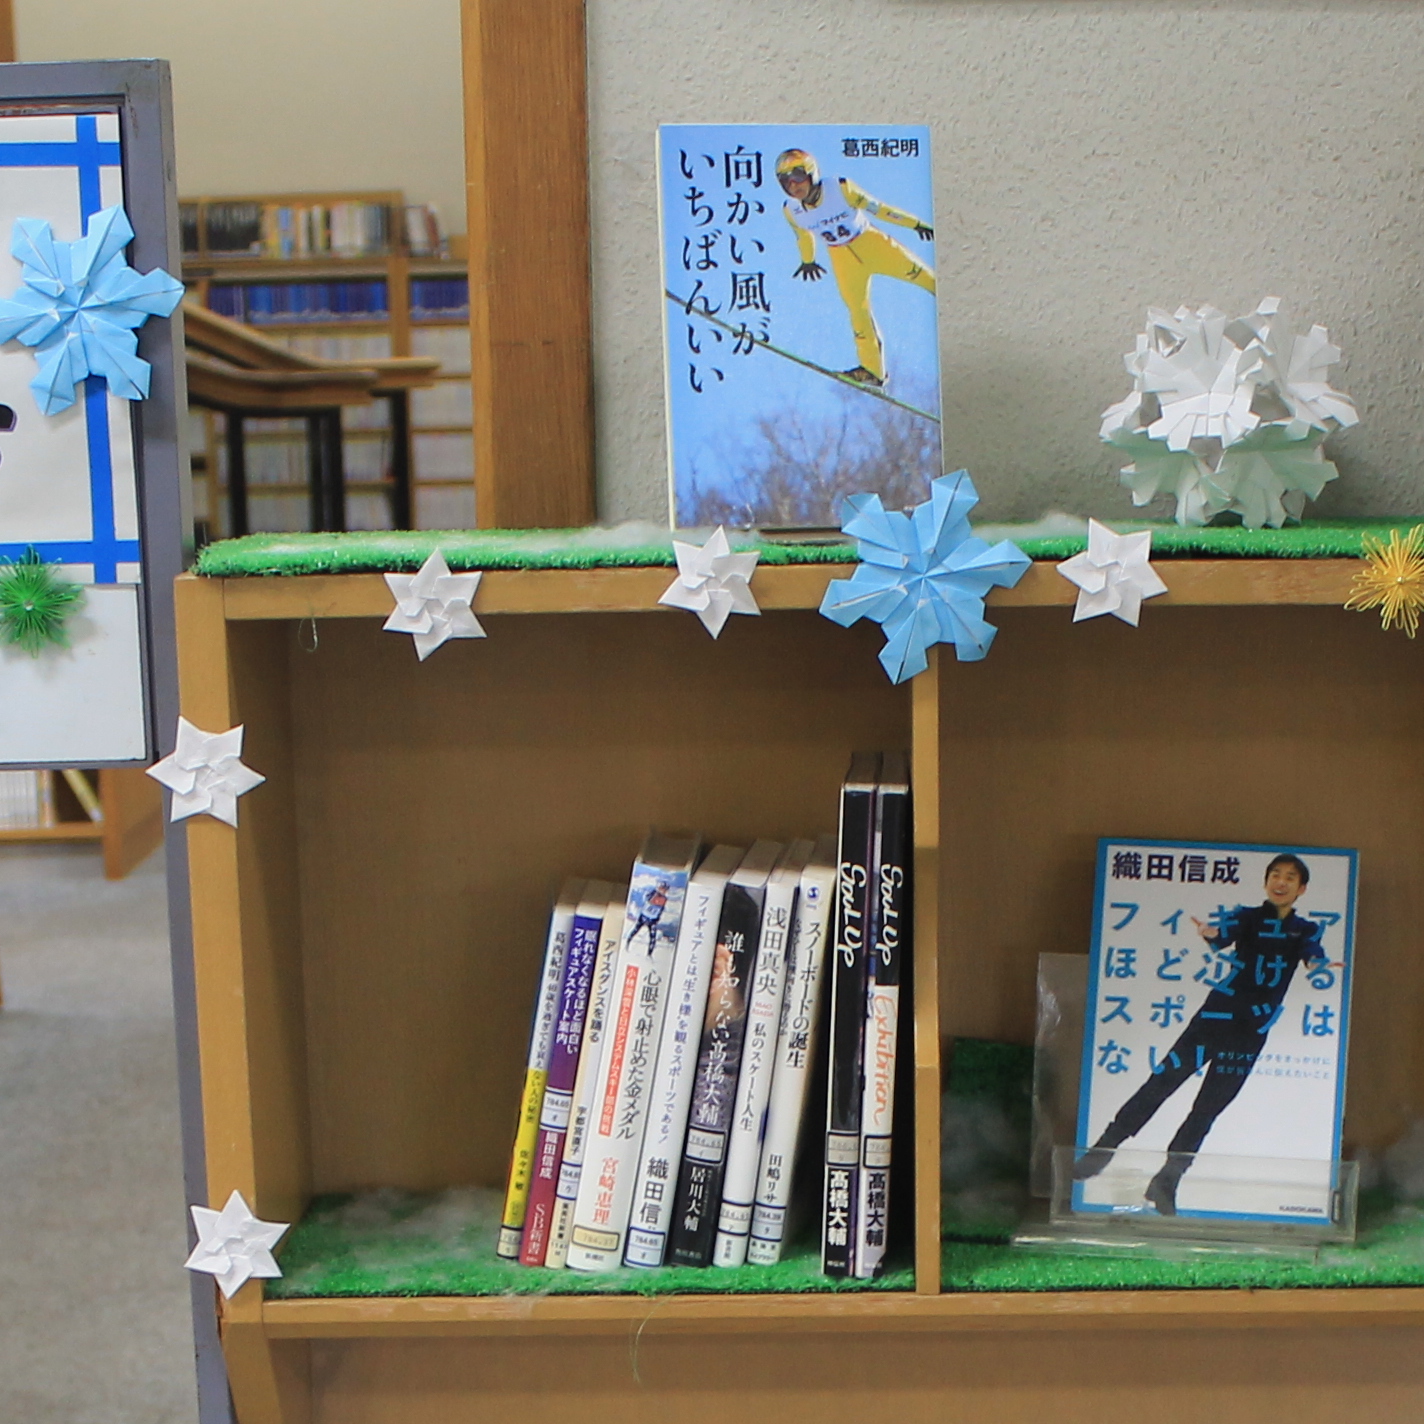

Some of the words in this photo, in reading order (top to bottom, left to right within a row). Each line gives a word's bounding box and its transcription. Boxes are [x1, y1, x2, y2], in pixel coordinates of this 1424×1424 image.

[841, 138, 919, 158] 葛西紀明
[680, 149, 724, 393] いちばんいい
[723, 145, 771, 355] 向かい風が
[1111, 850, 1241, 885] 織田信成
[756, 907, 788, 996] 浅田真央
[1109, 901, 1341, 943] フィギュア
[547, 931, 567, 983] 葛西紀明
[555, 928, 585, 1046] フィギュアスケート案内
[589, 939, 616, 1044] アイスダンスを踊る
[1103, 943, 1337, 997] ほど泣ける
[786, 920, 822, 1069] スノーボードの誕生
[1100, 996, 1337, 1037] スポーツは
[614, 968, 663, 1141] 心眼で射止めた金メダル
[739, 1022, 769, 1132] 私のスケート人生
[874, 995, 896, 1126] Exhibition
[1096, 1040, 1208, 1077] ない!
[538, 1130, 560, 1180] 織田信成
[592, 1156, 617, 1225] 宮崎恵理
[638, 1157, 669, 1230] 織田信
[683, 1166, 707, 1232] 居川大輔
[527, 1203, 546, 1256] SB新書
